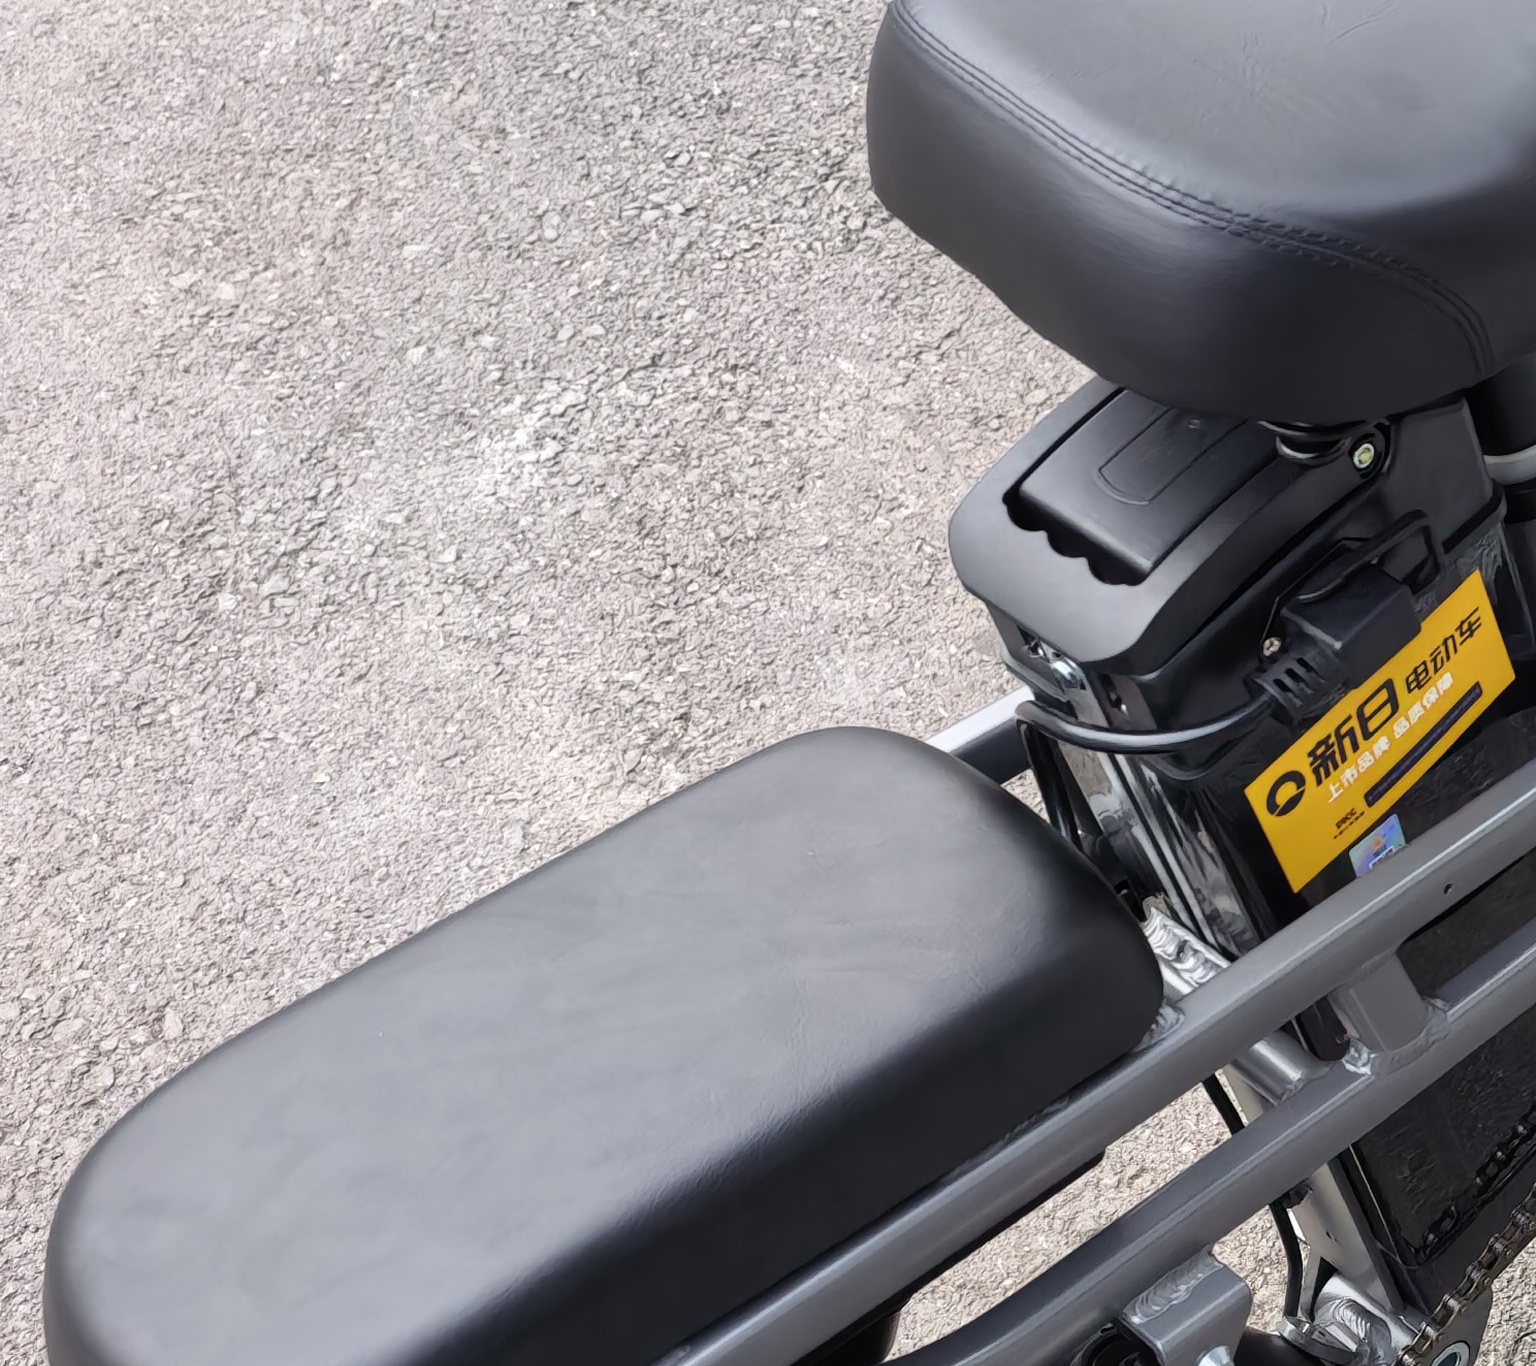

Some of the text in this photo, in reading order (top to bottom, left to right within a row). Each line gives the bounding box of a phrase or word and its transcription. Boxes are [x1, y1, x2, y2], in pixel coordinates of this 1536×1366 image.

[1306, 677, 1400, 788] 新日
[1405, 606, 1483, 695] 电动车
